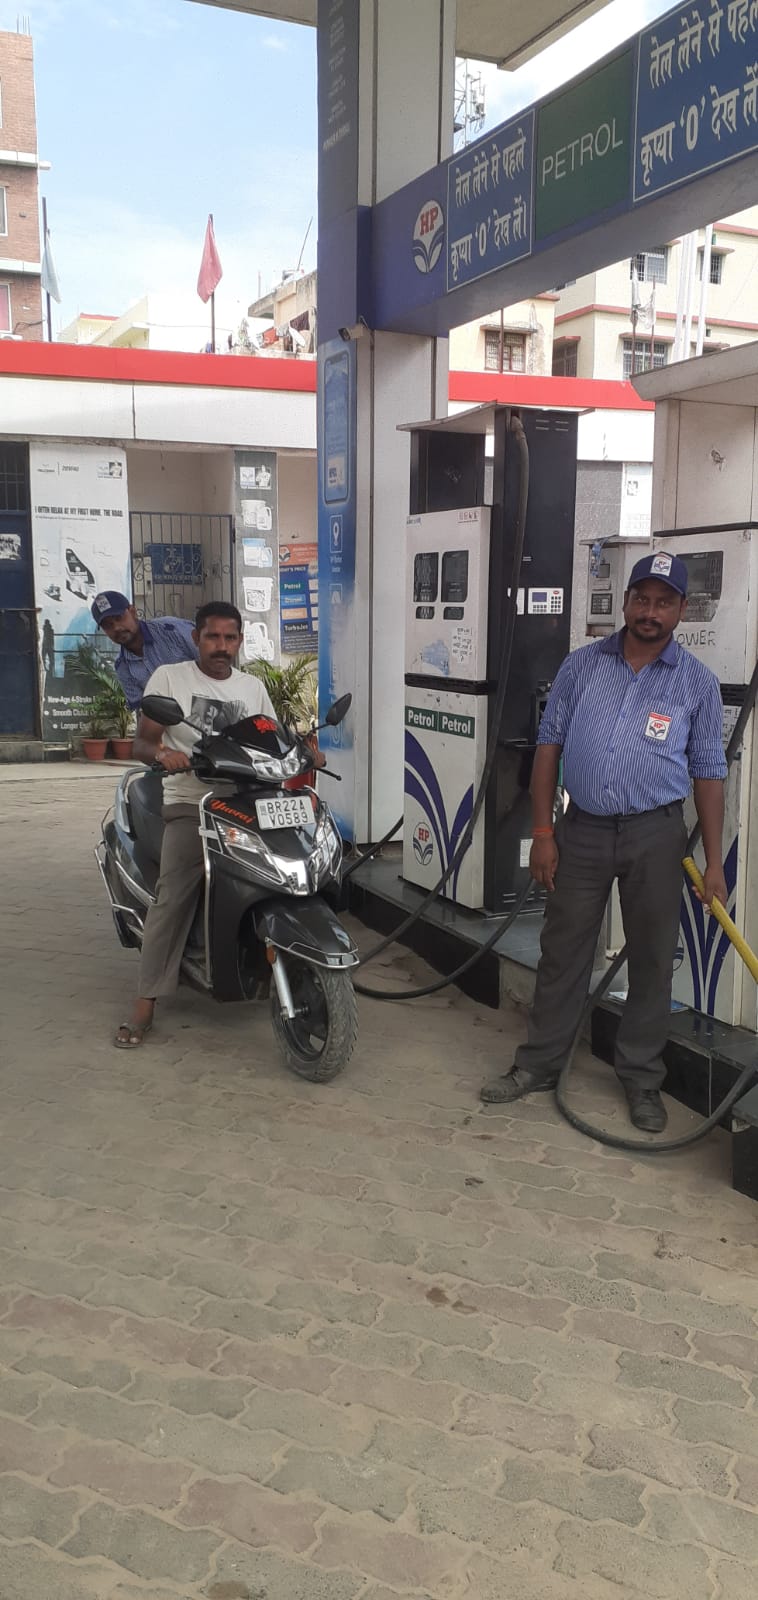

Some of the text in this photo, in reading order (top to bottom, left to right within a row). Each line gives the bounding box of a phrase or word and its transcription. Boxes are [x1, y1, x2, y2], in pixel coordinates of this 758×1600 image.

[649, 36, 676, 89] तेल
[677, 9, 705, 73] लेने
[710, 85, 740, 141] देख
[541, 117, 624, 187] PETROL
[455, 128, 526, 208] तेल लेने से पहले
[420, 206, 439, 236] HP
[493, 208, 511, 251] देख
[677, 629, 716, 647] OWER
[407, 709, 435, 728] Petrol
[441, 715, 471, 735] Petrol
[266, 799, 305, 814] BR22A
[269, 811, 308, 827] V0589
[418, 827, 430, 842] HP
